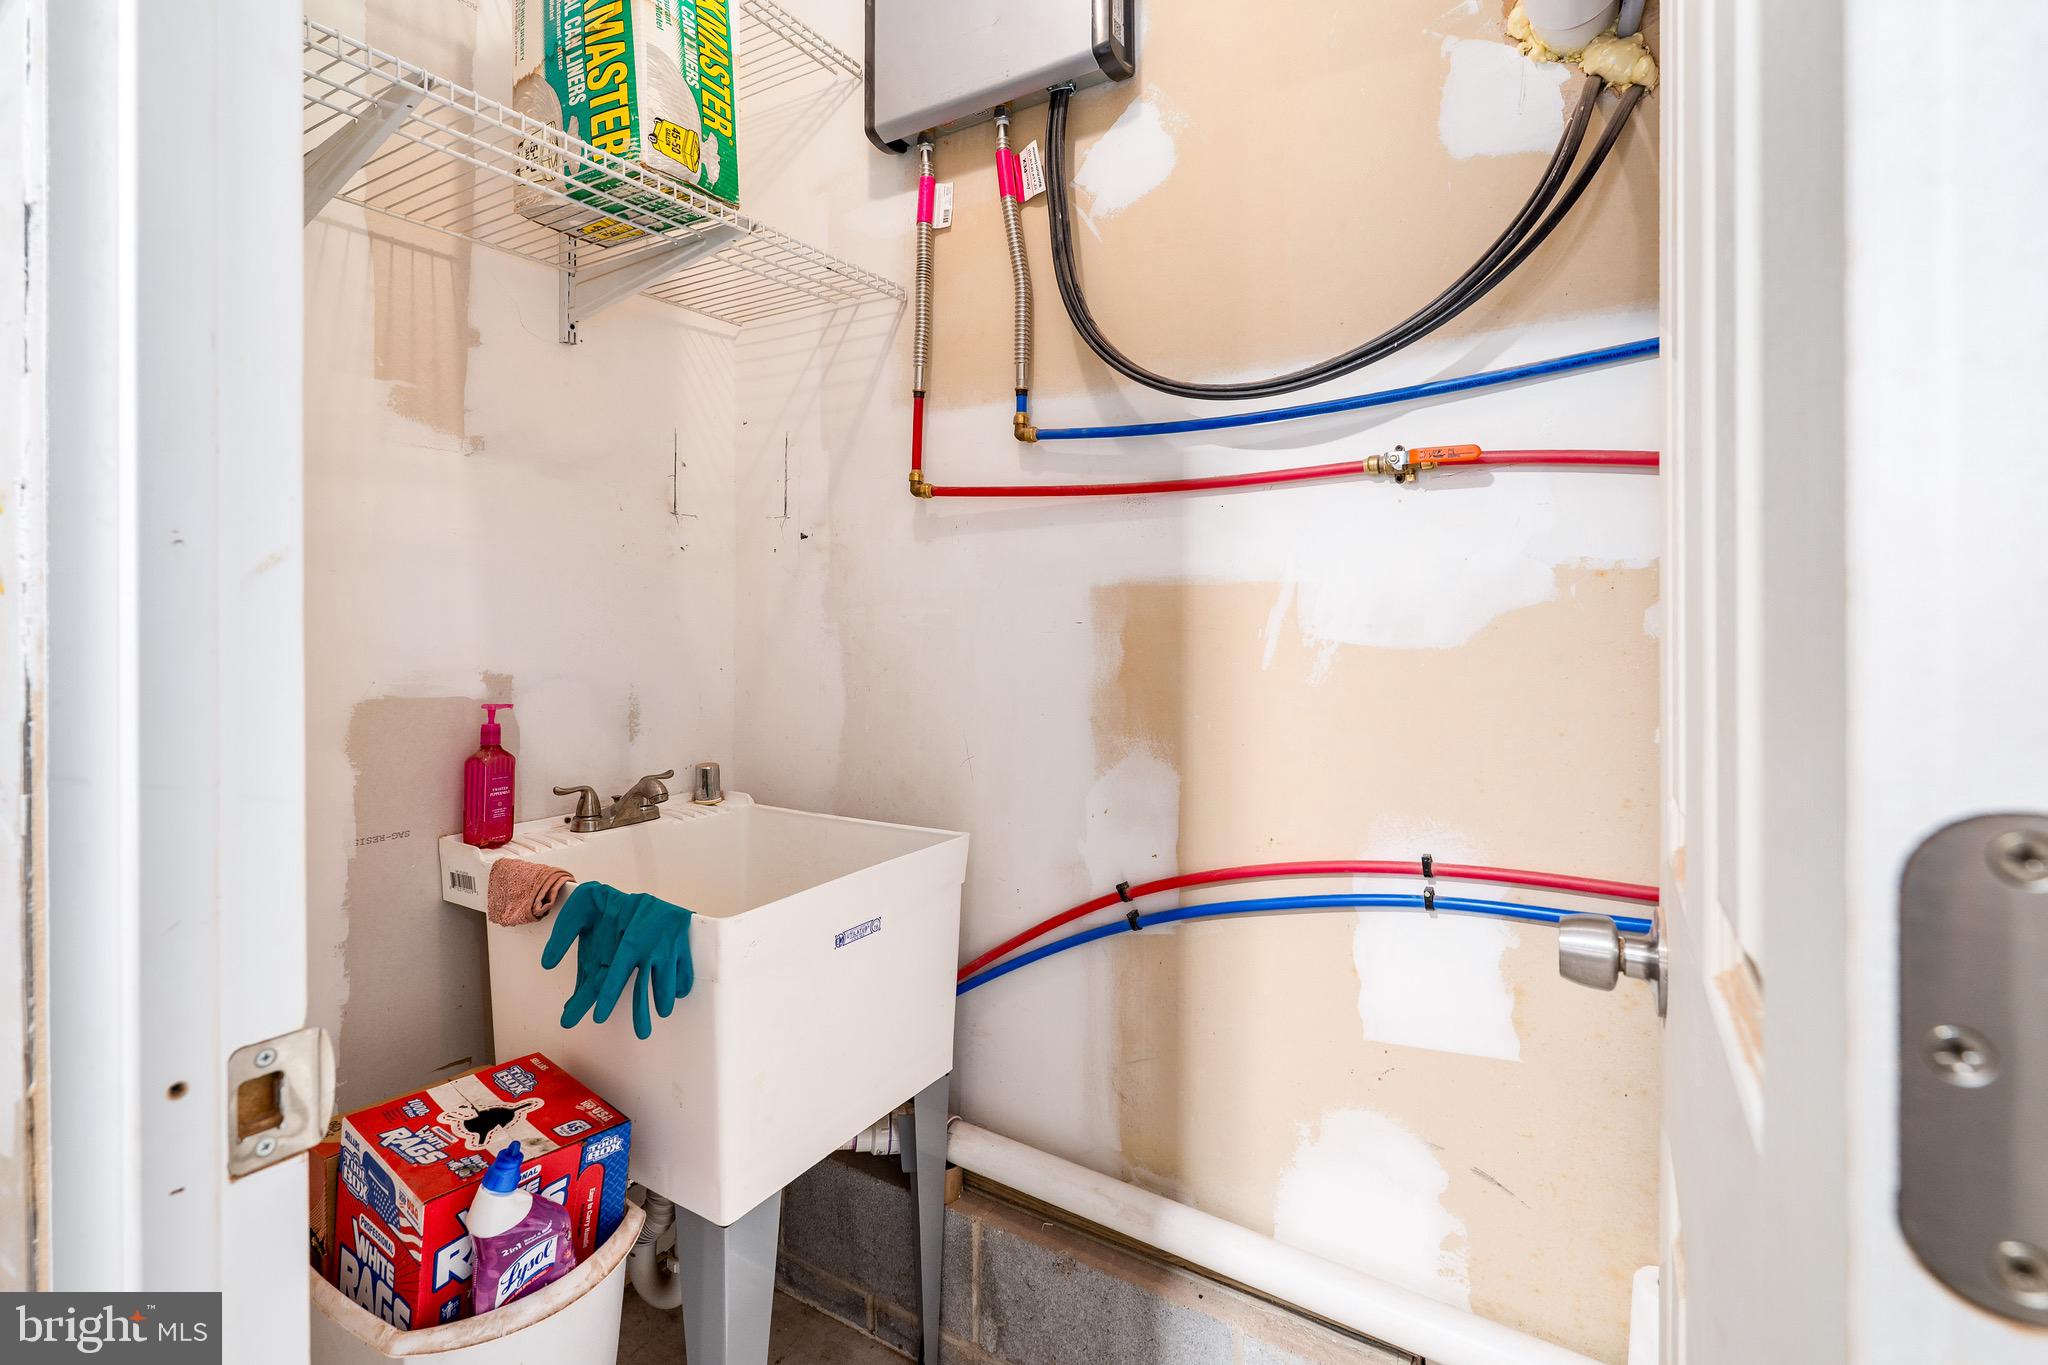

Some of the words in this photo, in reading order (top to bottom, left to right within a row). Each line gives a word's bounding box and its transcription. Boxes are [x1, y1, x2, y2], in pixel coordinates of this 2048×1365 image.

[564, 16, 582, 51] CAN
[681, 5, 696, 37] CAN
[565, 50, 586, 107] LINERS
[684, 37, 700, 89] LINERS
[671, 127, 681, 155] 45-50
[495, 1069, 527, 1097] BOX
[508, 1064, 537, 1088] TOOL
[414, 1123, 449, 1151] WHITE
[566, 1121, 584, 1133] 45
[378, 1126, 450, 1166] RAGS
[586, 1142, 623, 1161] BOX
[588, 1136, 621, 1152] TOOL
[343, 1151, 367, 1184] TOOL
[341, 1168, 370, 1203] BOX
[587, 1187, 596, 1202] Easy
[352, 1217, 396, 1287] WHITE
[360, 1217, 394, 1256] PROFESSIONAL
[501, 1242, 522, 1257] 2in1
[500, 1239, 552, 1296] Lysol
[338, 1247, 412, 1330] RAGS
